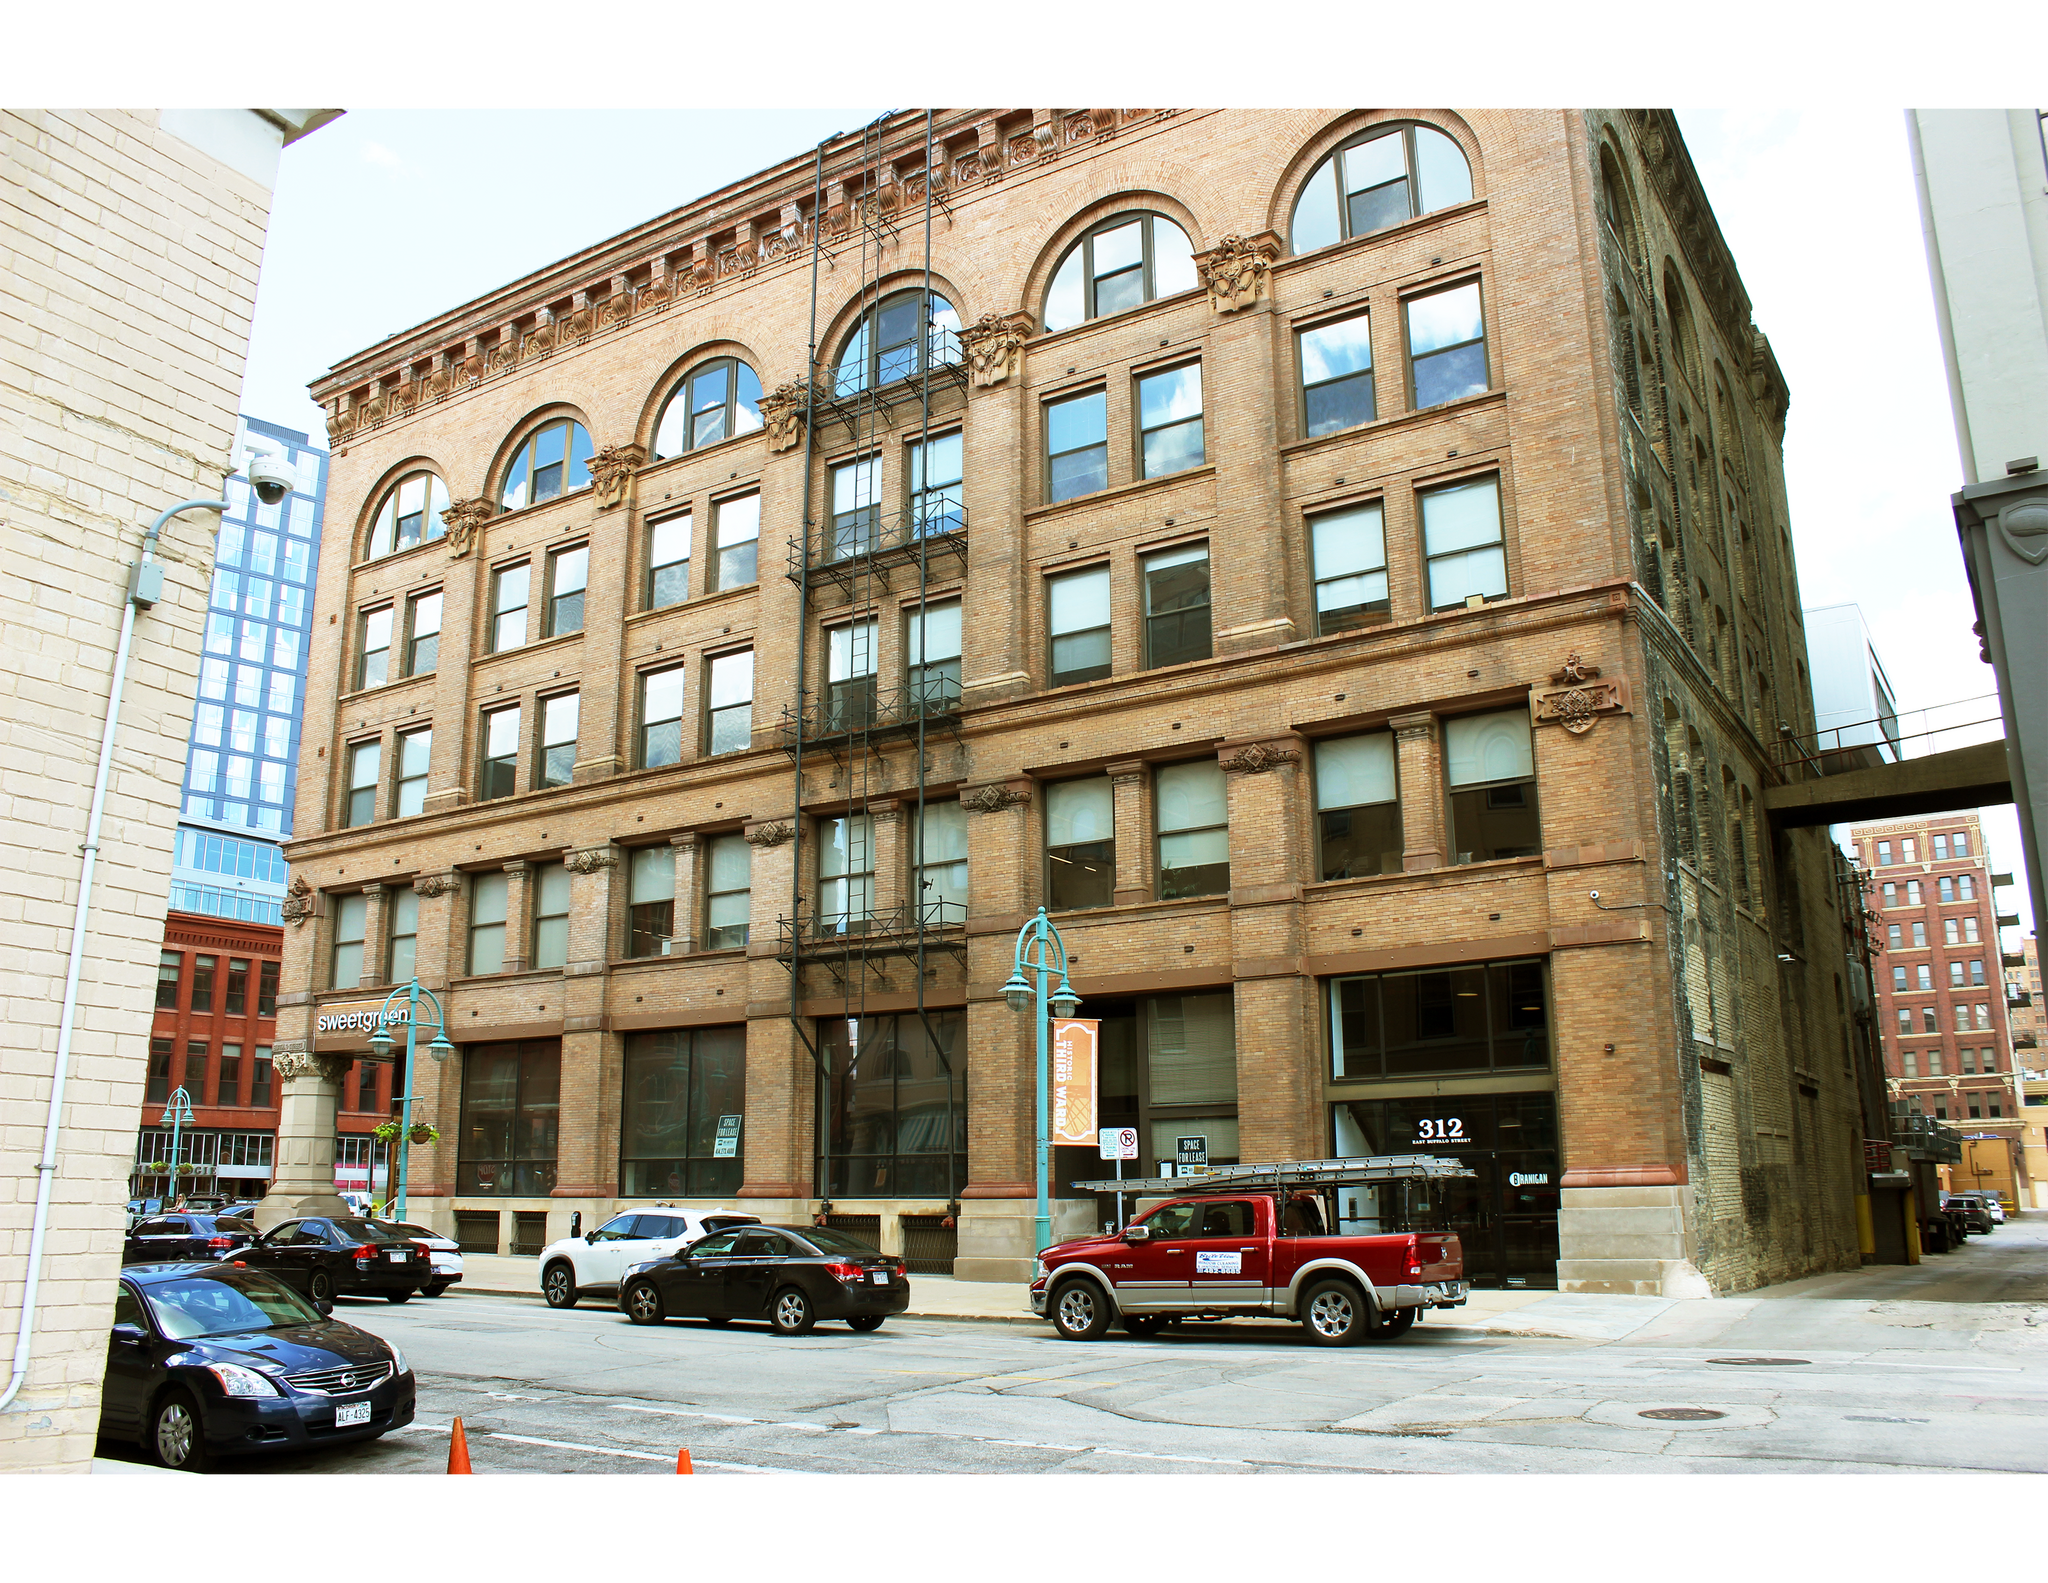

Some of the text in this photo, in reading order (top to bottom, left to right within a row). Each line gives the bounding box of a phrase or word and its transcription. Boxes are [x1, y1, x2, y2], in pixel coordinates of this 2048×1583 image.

[318, 1008, 409, 1032] sweetgreen
[1056, 1040, 1067, 1127] THIRD WARD
[724, 1118, 737, 1126] SPACE
[1419, 1117, 1464, 1138] 312
[718, 1127, 738, 1137] FOR LEASE
[1183, 1139, 1200, 1150] SPACE
[1179, 1151, 1206, 1163] FOR LEASE
[1509, 1171, 1549, 1187] BRANIGAN
